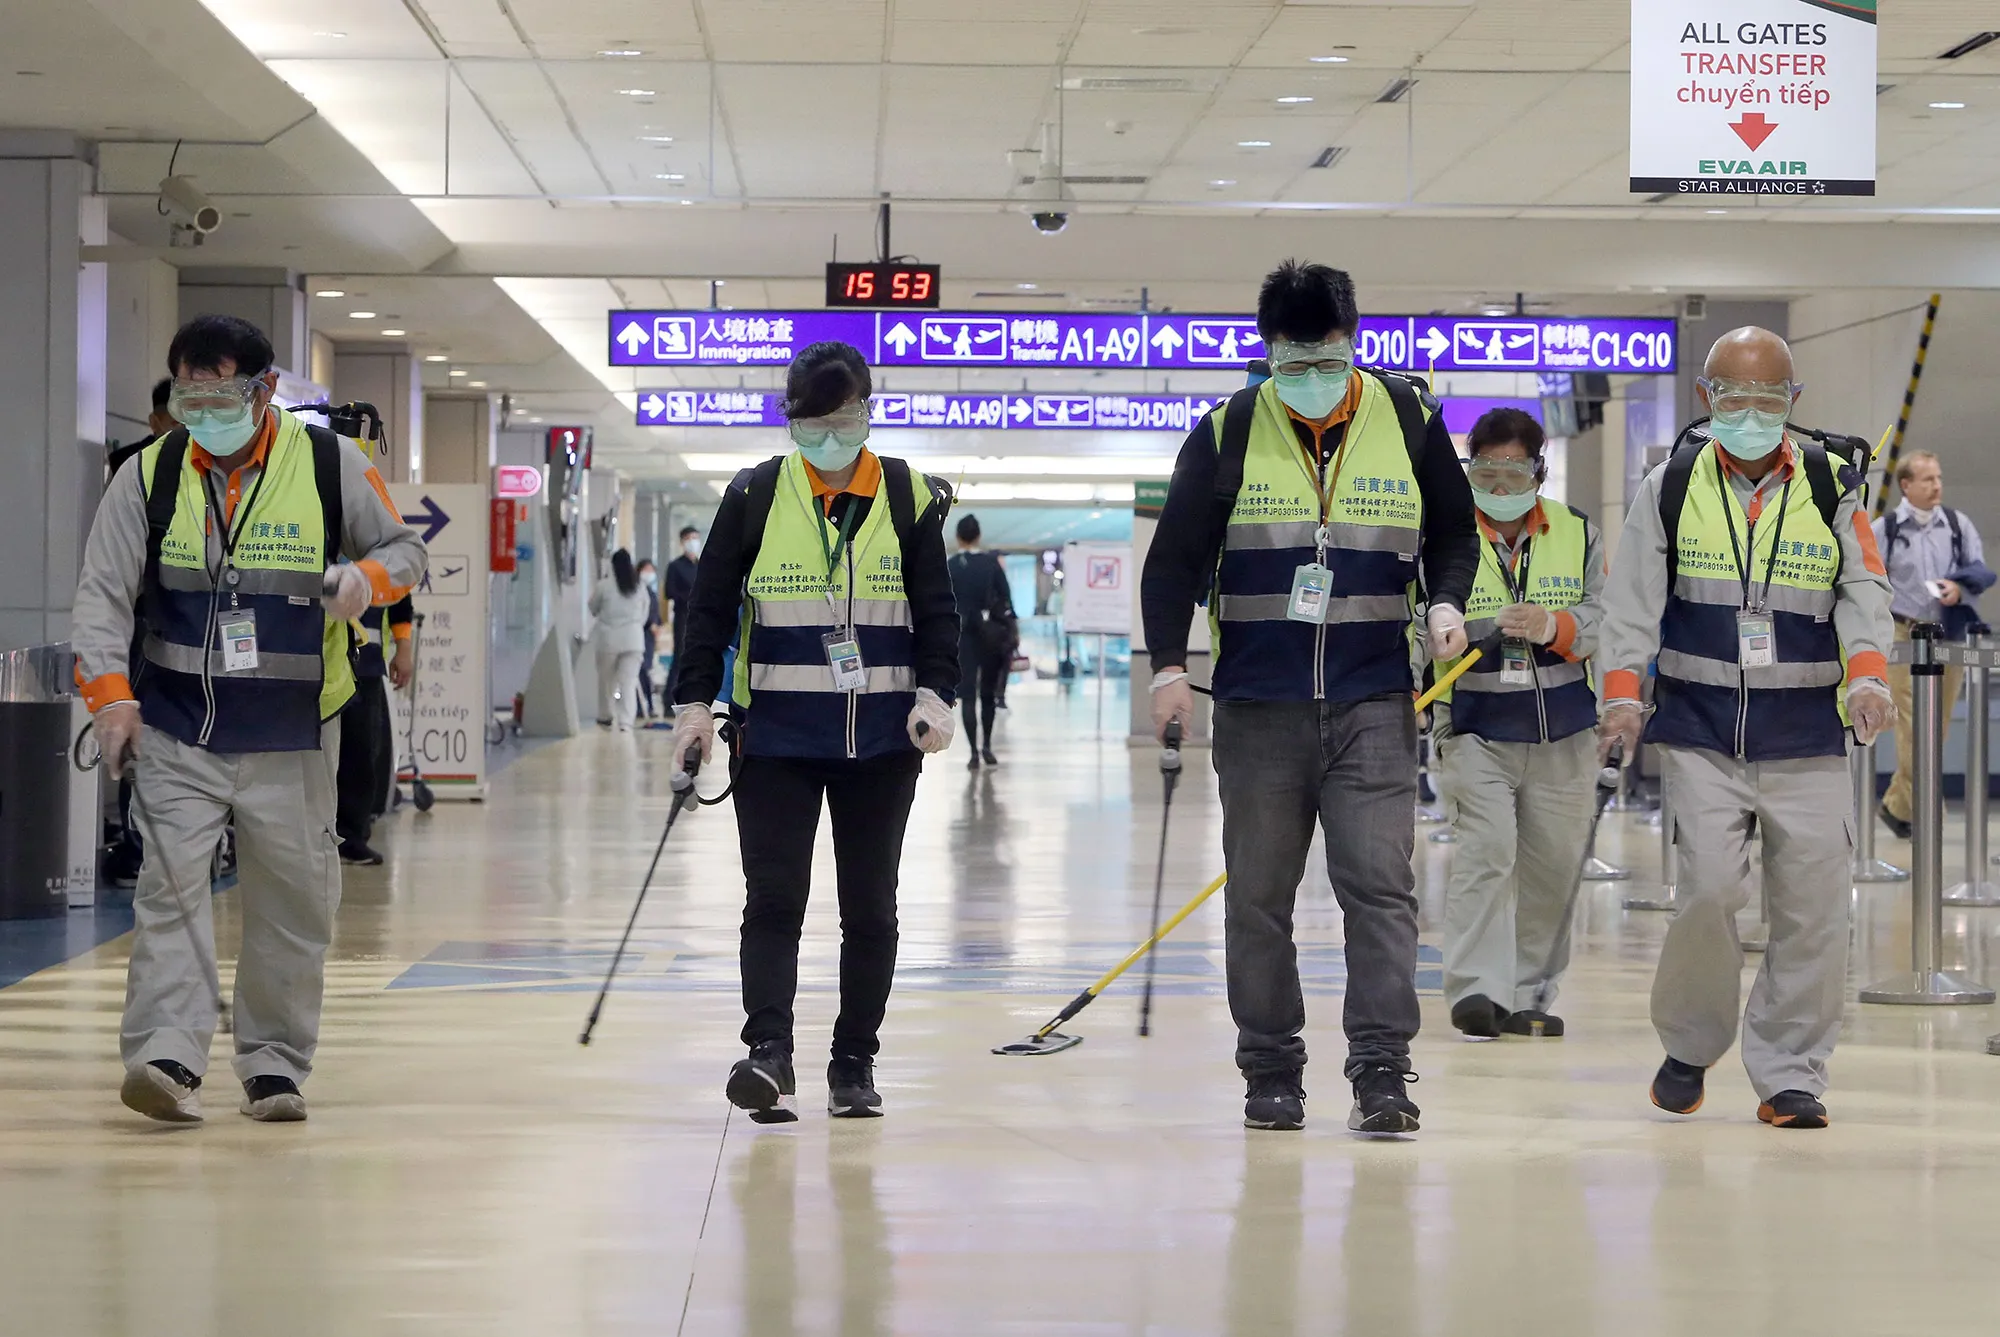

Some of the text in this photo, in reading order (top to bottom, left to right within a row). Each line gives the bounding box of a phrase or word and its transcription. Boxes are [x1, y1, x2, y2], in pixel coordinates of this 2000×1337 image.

[1680, 22, 1827, 46] ALL GATES
[1681, 53, 1826, 76] TRANSFER
[1677, 79, 1831, 111] chuyển tiếp
[1678, 180, 1806, 194] STAR ALLIANCE
[846, 272, 932, 300] 15 53
[699, 317, 794, 343] 入境檢查
[1010, 319, 1059, 345] 轉機
[1542, 324, 1590, 349] 轉機
[698, 344, 792, 363] Immigration
[1010, 344, 1058, 361] Transfer
[1060, 326, 1140, 362] A1-A9
[1591, 330, 1672, 368] C1-C10
[1542, 349, 1590, 366] Transfer
[698, 392, 764, 412] 入境檢查
[946, 399, 1002, 426] A1-A9
[698, 411, 763, 425] Immigration
[1128, 402, 1185, 428] D1-D10
[1353, 476, 1408, 496] 信實集團
